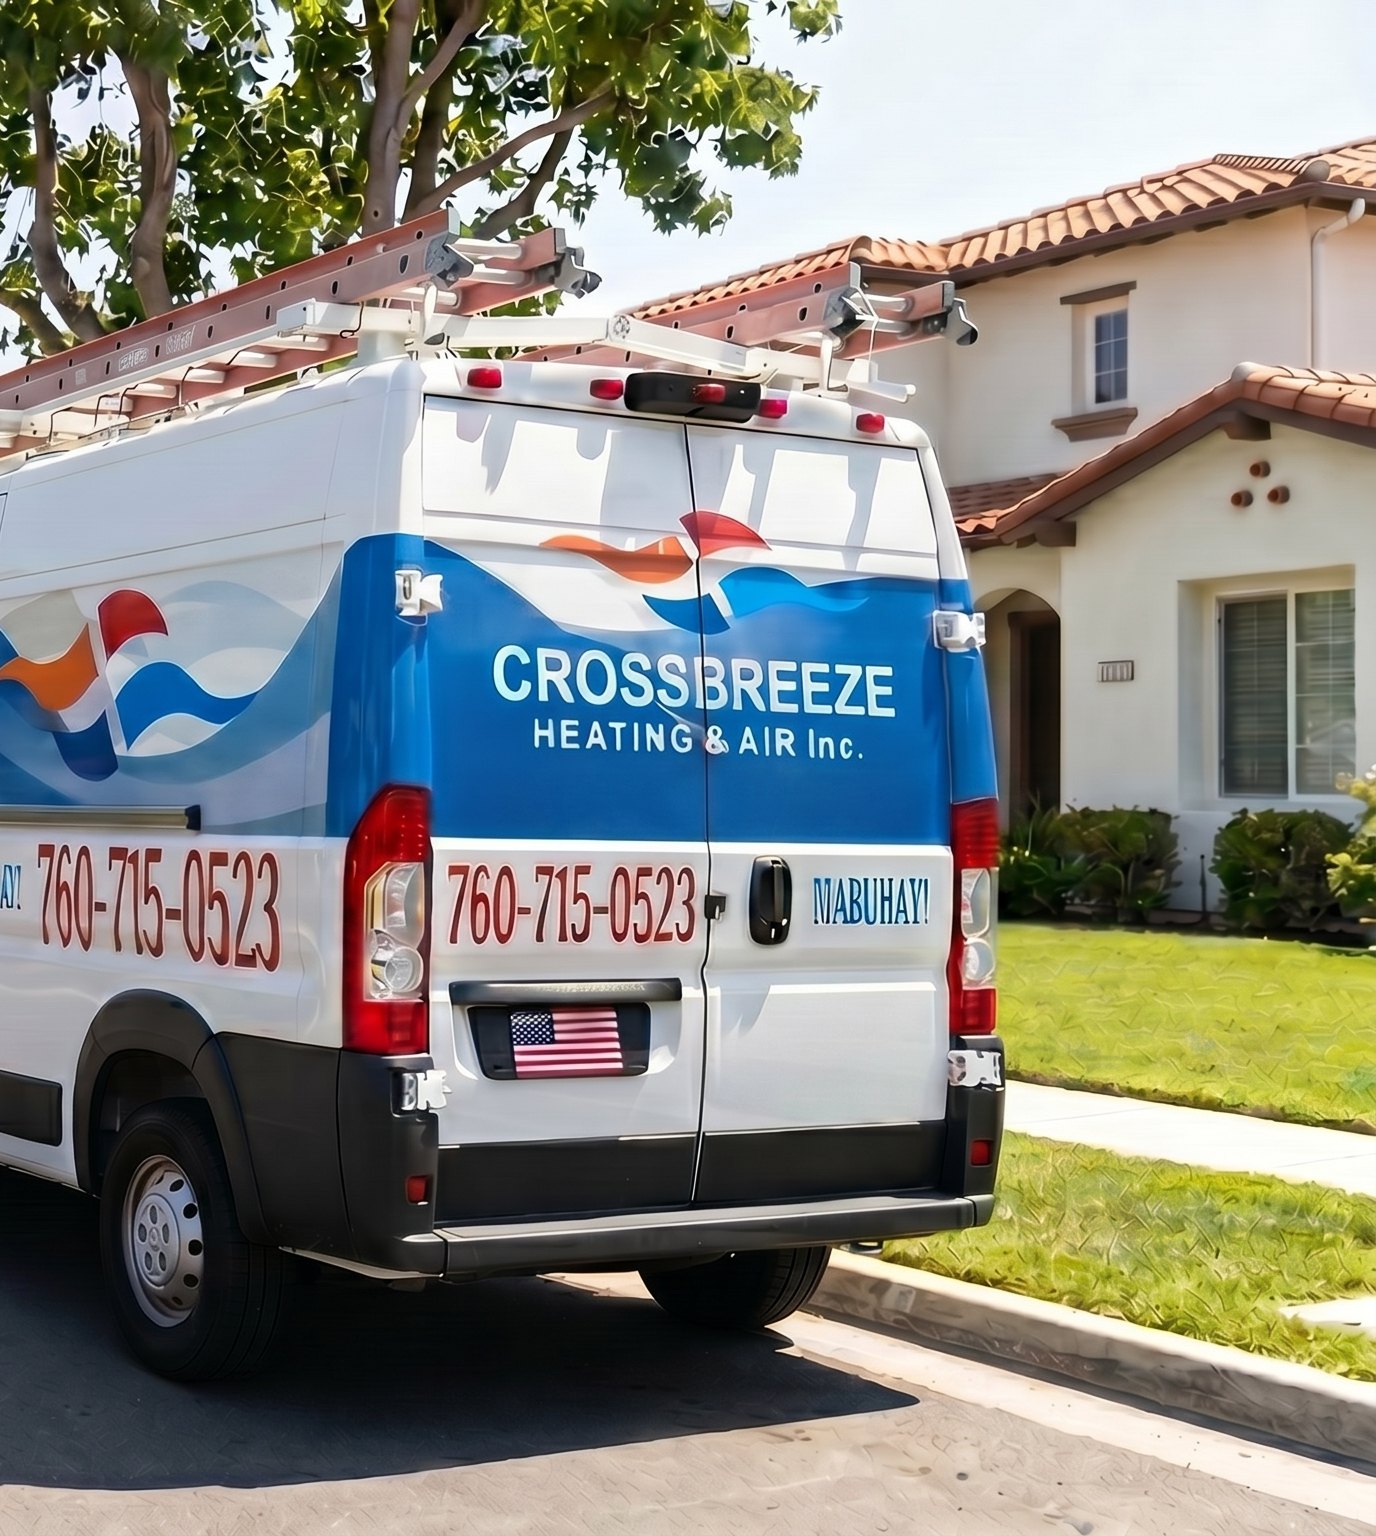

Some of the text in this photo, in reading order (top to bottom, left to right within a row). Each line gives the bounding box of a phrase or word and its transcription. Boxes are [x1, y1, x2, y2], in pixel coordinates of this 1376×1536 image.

[492, 645, 896, 718] CROSSBREEZE
[534, 718, 863, 760] HEATING & AIR Inc.
[37, 843, 281, 973] 760-715-0523
[448, 864, 696, 945] 760-715-0523
[813, 877, 930, 926] MABUHAY!
